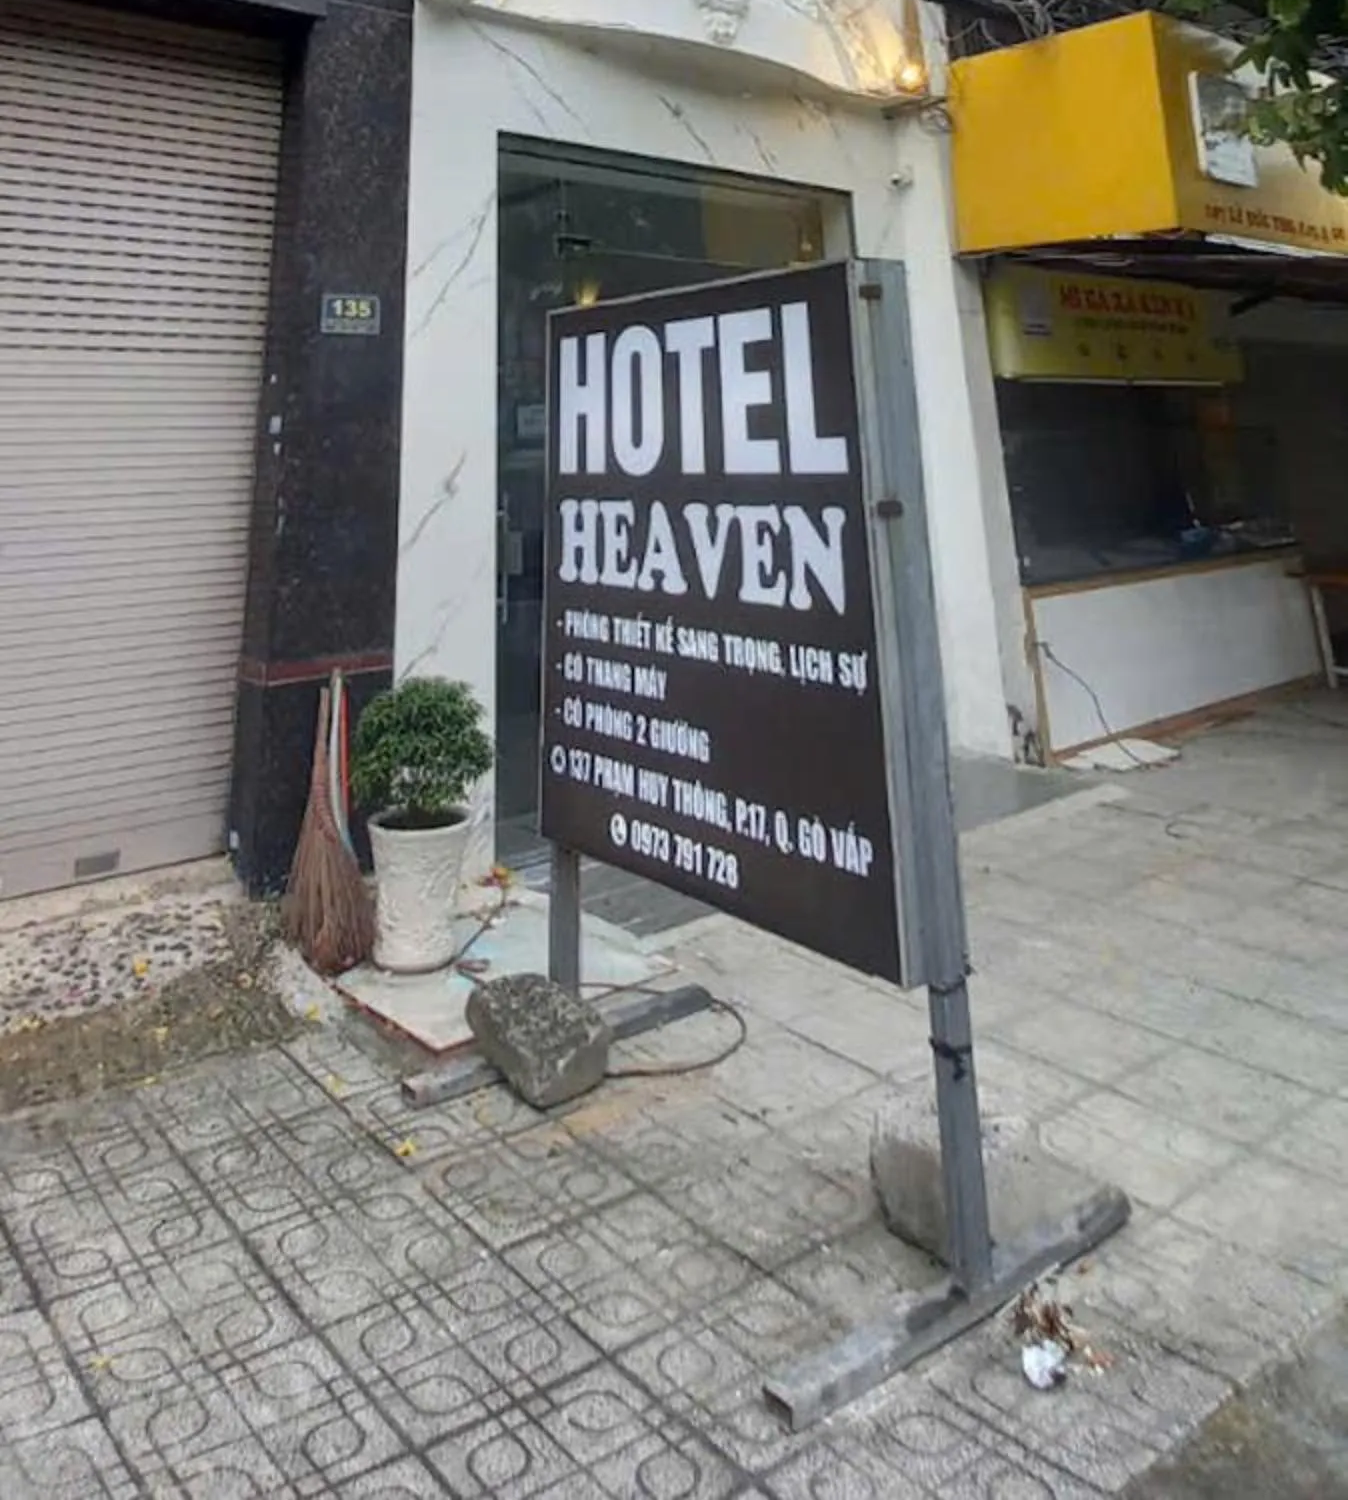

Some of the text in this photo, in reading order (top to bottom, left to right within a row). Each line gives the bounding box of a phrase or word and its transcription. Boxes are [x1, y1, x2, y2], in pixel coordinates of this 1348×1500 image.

[331, 298, 372, 317] 135
[559, 301, 849, 476] HOTEL
[559, 499, 848, 615] HEAVEN
[586, 656, 632, 692] THANG
[634, 663, 667, 700] MÁY
[676, 626, 719, 662] SANG
[789, 644, 833, 686] LỊCH
[837, 651, 868, 696] SỰ
[635, 714, 647, 746] 2
[568, 749, 592, 782] 137
[594, 754, 635, 798] PHẠM
[638, 767, 669, 807] HUY
[774, 810, 794, 854] Q.
[798, 814, 827, 863] GÒ
[829, 820, 873, 877] VẤP
[630, 818, 740, 889] 0973 791 728
